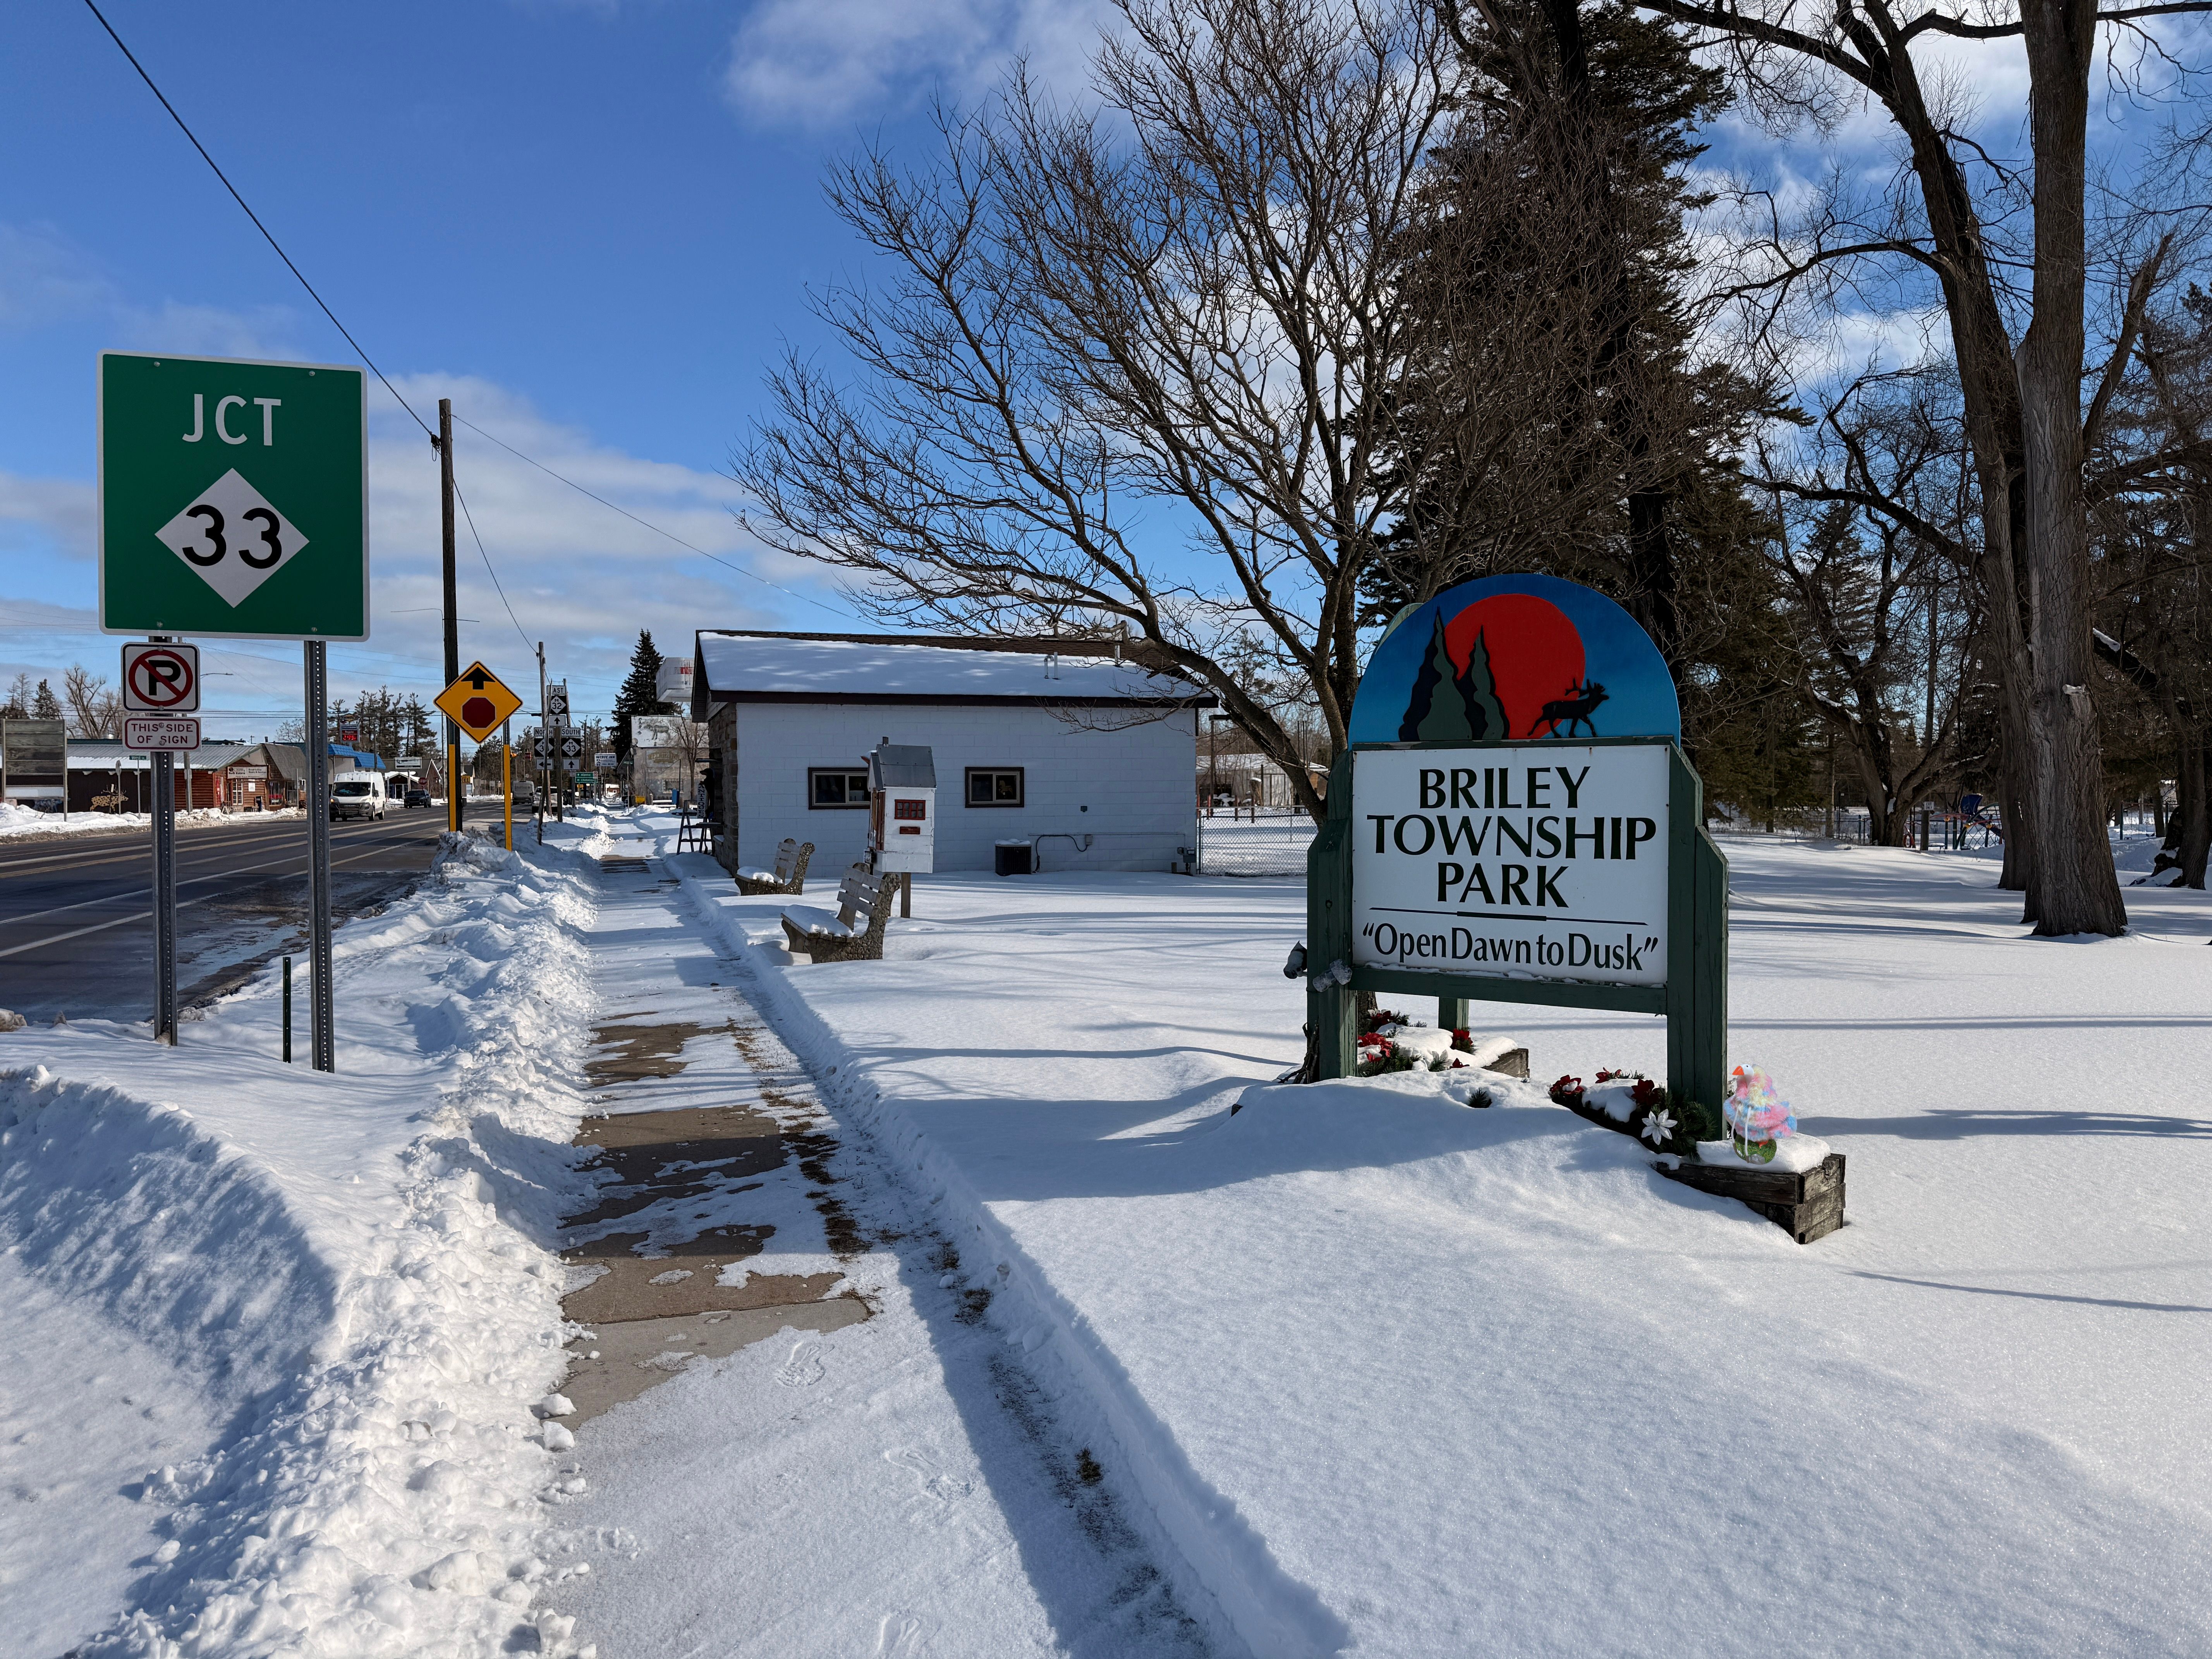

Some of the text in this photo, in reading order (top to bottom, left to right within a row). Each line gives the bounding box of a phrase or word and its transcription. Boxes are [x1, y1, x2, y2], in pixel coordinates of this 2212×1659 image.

[182, 394, 281, 446] JCT
[182, 505, 282, 569] 33
[148, 660, 181, 696] P
[131, 724, 193, 732] THIS SIDE
[137, 735, 188, 744] OF SIGN
[1419, 766, 1591, 809] BRILEY
[1367, 814, 1656, 860] TOWNSHIP
[1437, 862, 1569, 908] PARK
